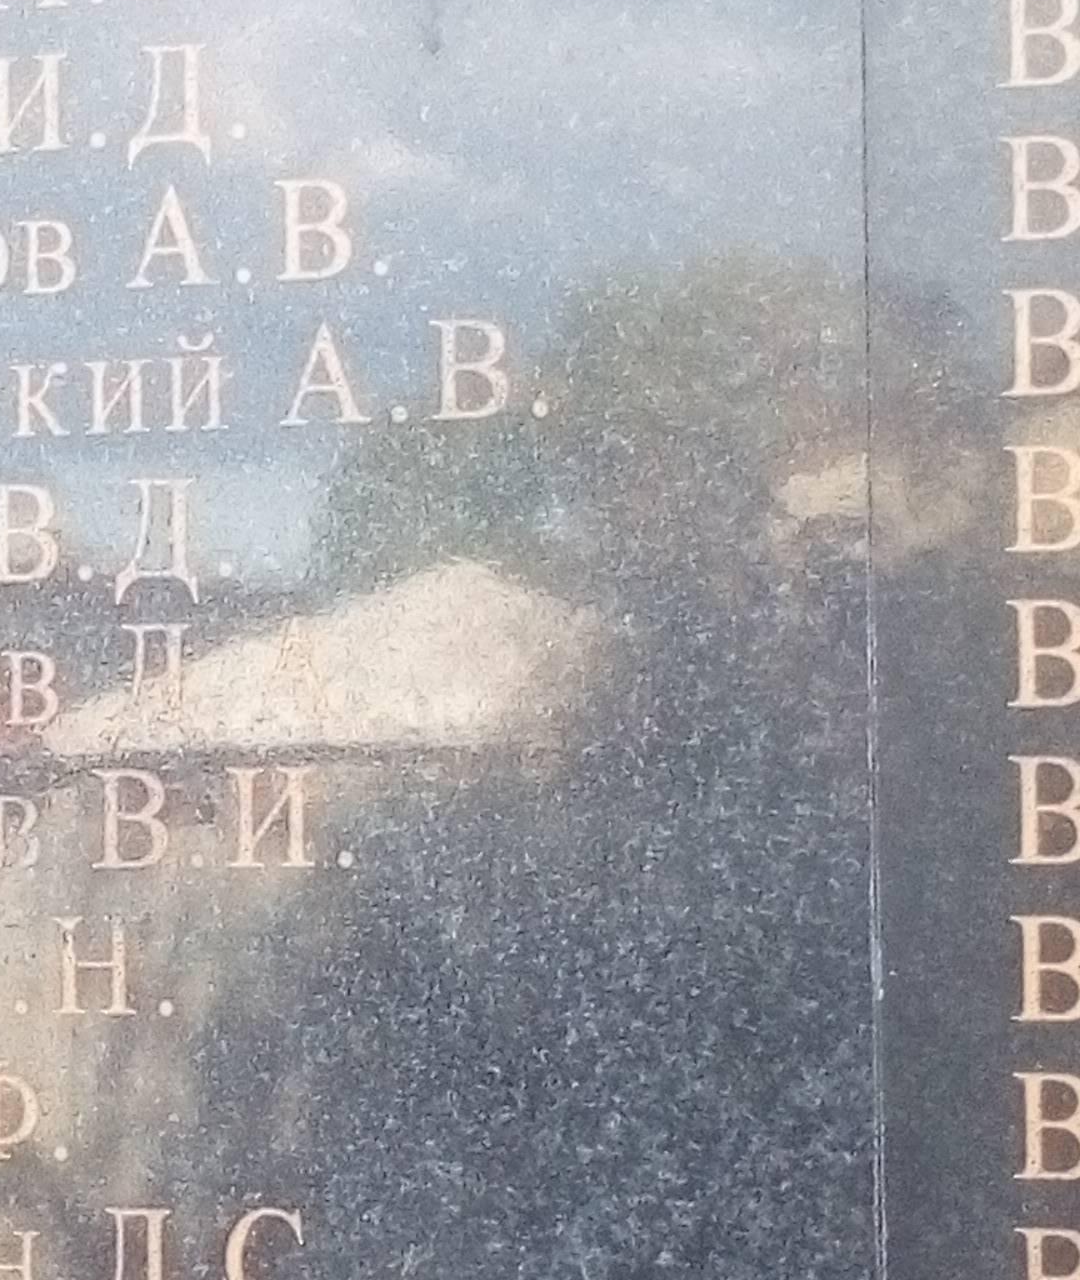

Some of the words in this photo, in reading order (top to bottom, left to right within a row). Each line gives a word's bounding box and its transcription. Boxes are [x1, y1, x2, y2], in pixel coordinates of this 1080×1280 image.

[125, 176, 391, 291] А.В.
[280, 319, 550, 430] А.В.
[92, 765, 356, 872] В.И.
